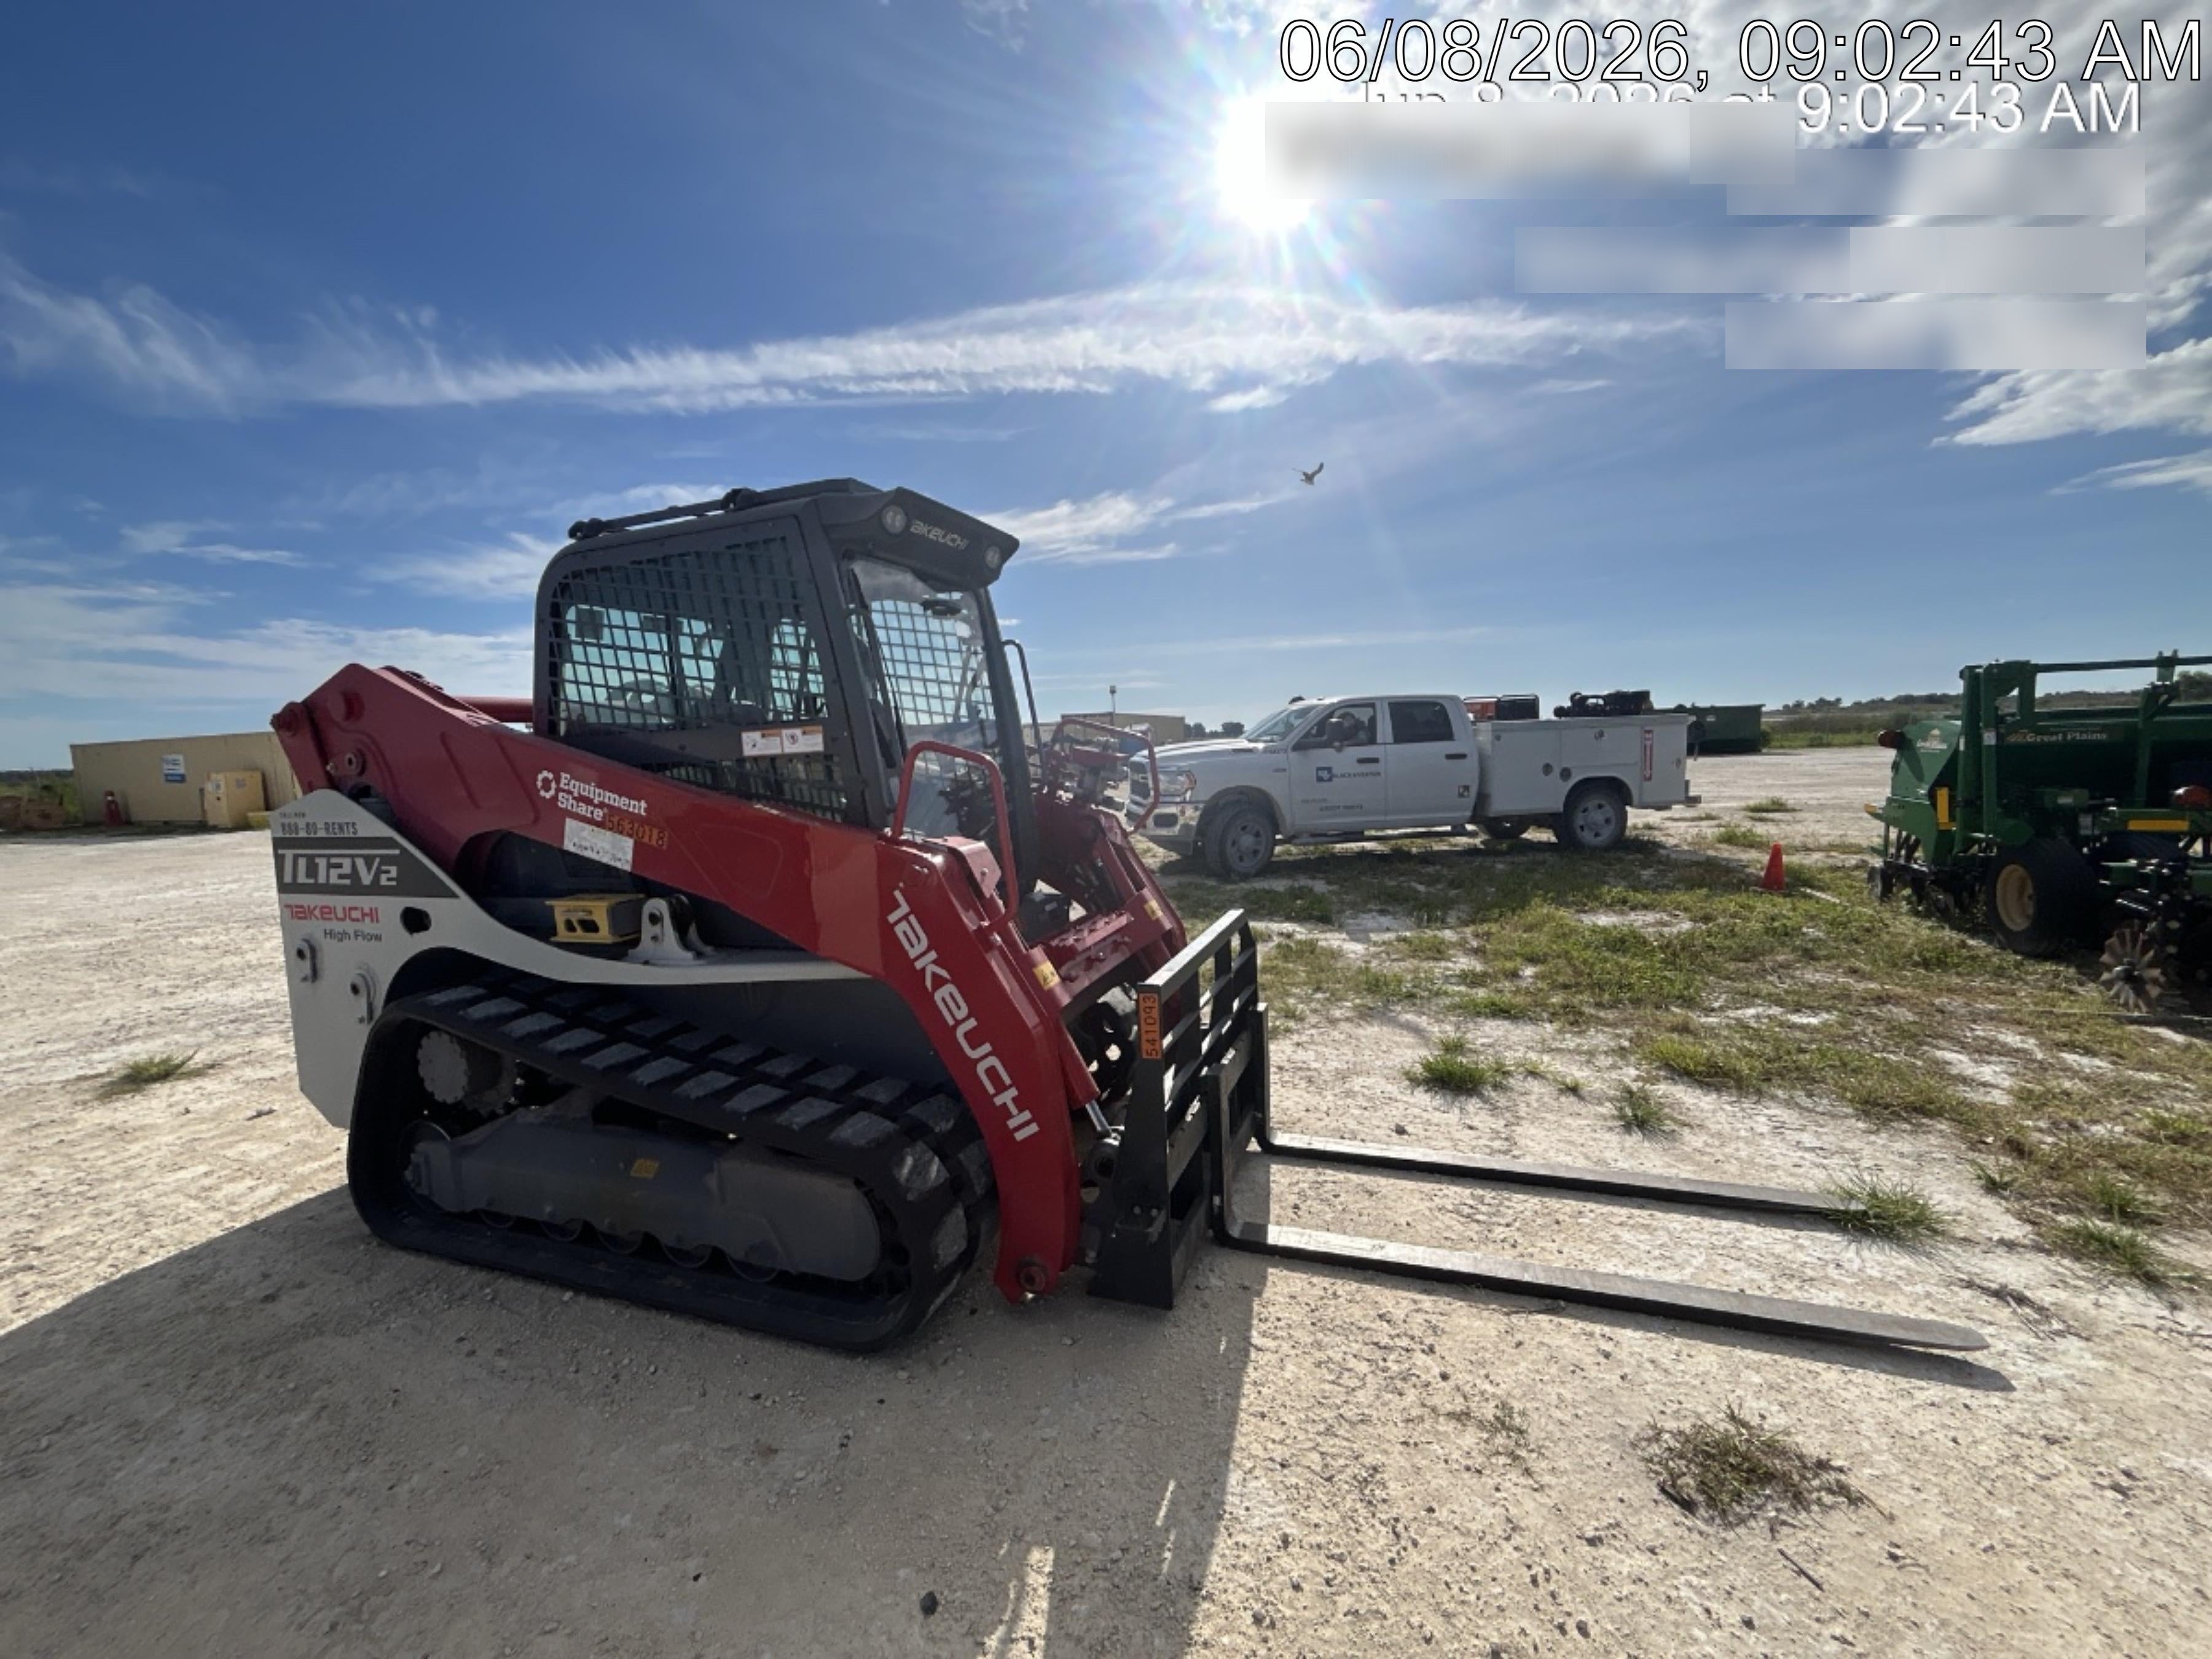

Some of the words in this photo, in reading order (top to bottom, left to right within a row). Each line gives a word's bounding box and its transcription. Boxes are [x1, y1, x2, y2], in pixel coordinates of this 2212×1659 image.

[558, 792, 604, 821] Share
[560, 772, 648, 815] Equipment
[606, 816, 667, 848] 563018
[278, 849, 400, 885] TL12V2
[324, 928, 351, 943] High
[353, 929, 382, 942] Flow
[1142, 995, 1159, 1057] 541093
